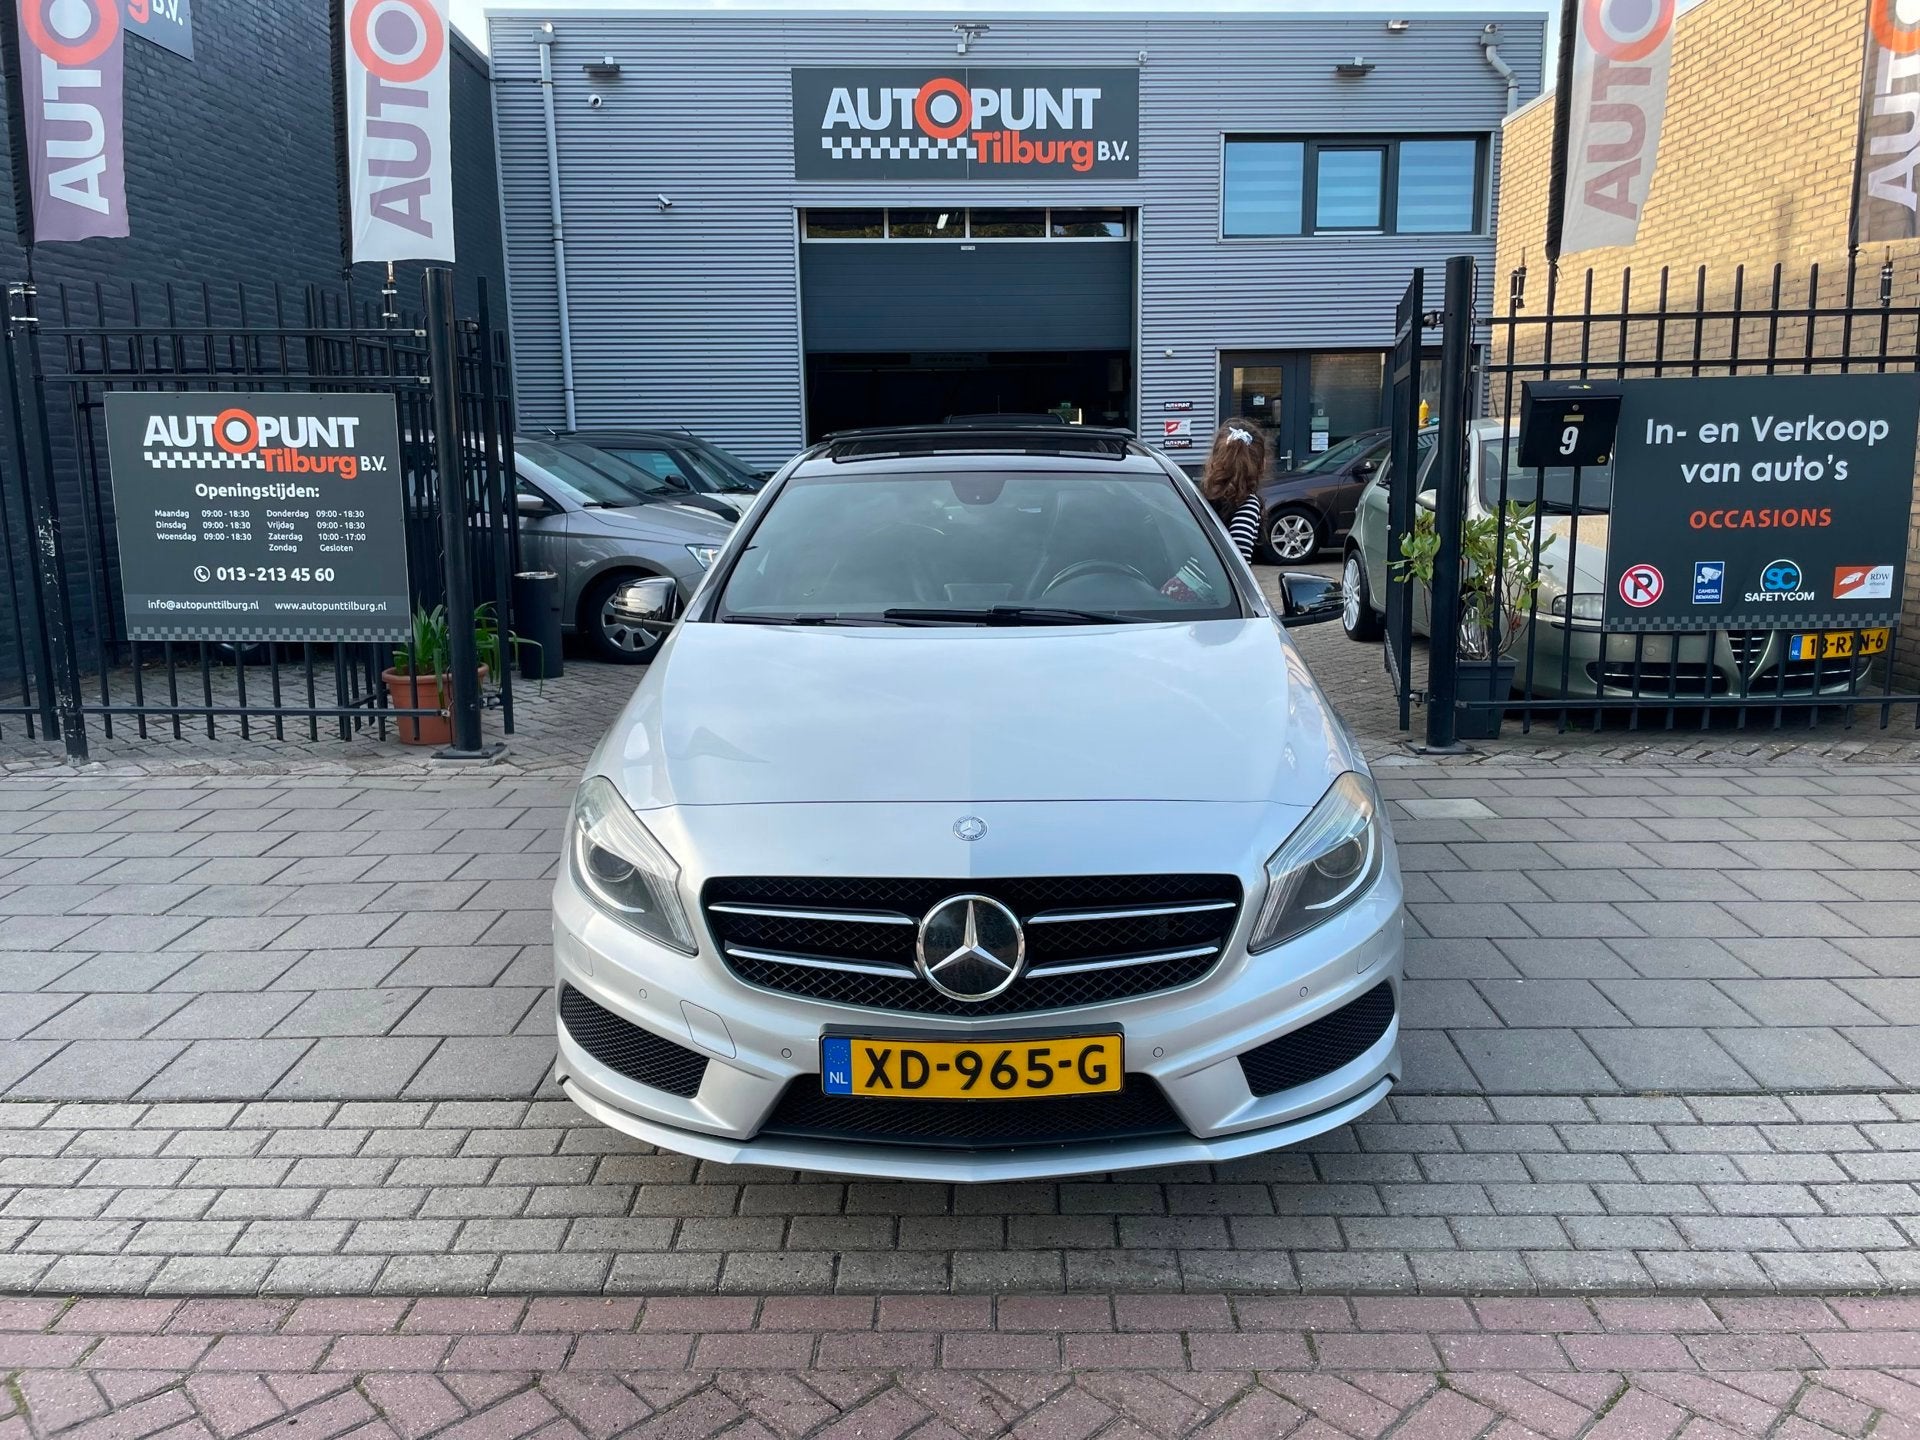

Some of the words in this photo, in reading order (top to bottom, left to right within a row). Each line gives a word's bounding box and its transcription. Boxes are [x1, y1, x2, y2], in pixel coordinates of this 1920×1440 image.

[821, 77, 1102, 140] AUTOPUNT
[972, 130, 1094, 172] Tilburg
[1097, 140, 1130, 162] B.V.
[143, 407, 360, 455] AUTOPUNT
[1645, 418, 1688, 445] In-
[1699, 422, 1740, 444] en
[1751, 414, 1889, 447] Verkoop
[1559, 426, 1579, 455] 9
[260, 447, 358, 480] Tilburg
[360, 455, 388, 472] B.V.
[1680, 462, 1741, 484] van
[1751, 454, 1848, 483] auto's
[195, 482, 320, 500] Openingstijden:
[154, 509, 190, 519] Maandag
[201, 510, 223, 518] 09:00
[229, 510, 250, 518] 18:30
[266, 509, 309, 519] Donderdag
[316, 510, 338, 518] 09:00
[344, 510, 365, 518] 18:30
[1689, 508, 1832, 530] OCCASIONS
[155, 521, 187, 530] Dinsdag
[202, 521, 224, 529] 09:00
[230, 521, 251, 530] 18:30
[267, 521, 295, 530] Vrijdag
[317, 521, 339, 529] 09:00
[345, 521, 366, 530] 18:30
[156, 533, 197, 542] Woensdag
[203, 533, 225, 541] 09:00
[231, 533, 252, 541] 18:30
[268, 533, 303, 542] Zaterdag
[318, 533, 340, 541] 10:00
[345, 533, 366, 541] 17:00
[268, 544, 297, 553] Zondag
[319, 544, 354, 552] Gesloten
[290, 567, 311, 582] 45
[315, 567, 335, 582] 60
[1870, 573, 1890, 581] RDW
[1744, 591, 1815, 602] SAFETYCOM
[147, 600, 260, 611] info@autopunttilburg.nl
[274, 601, 387, 612] www.autopunttilburg.nl
[864, 1043, 1108, 1091] XD-965-G
[829, 1071, 849, 1085] NL
